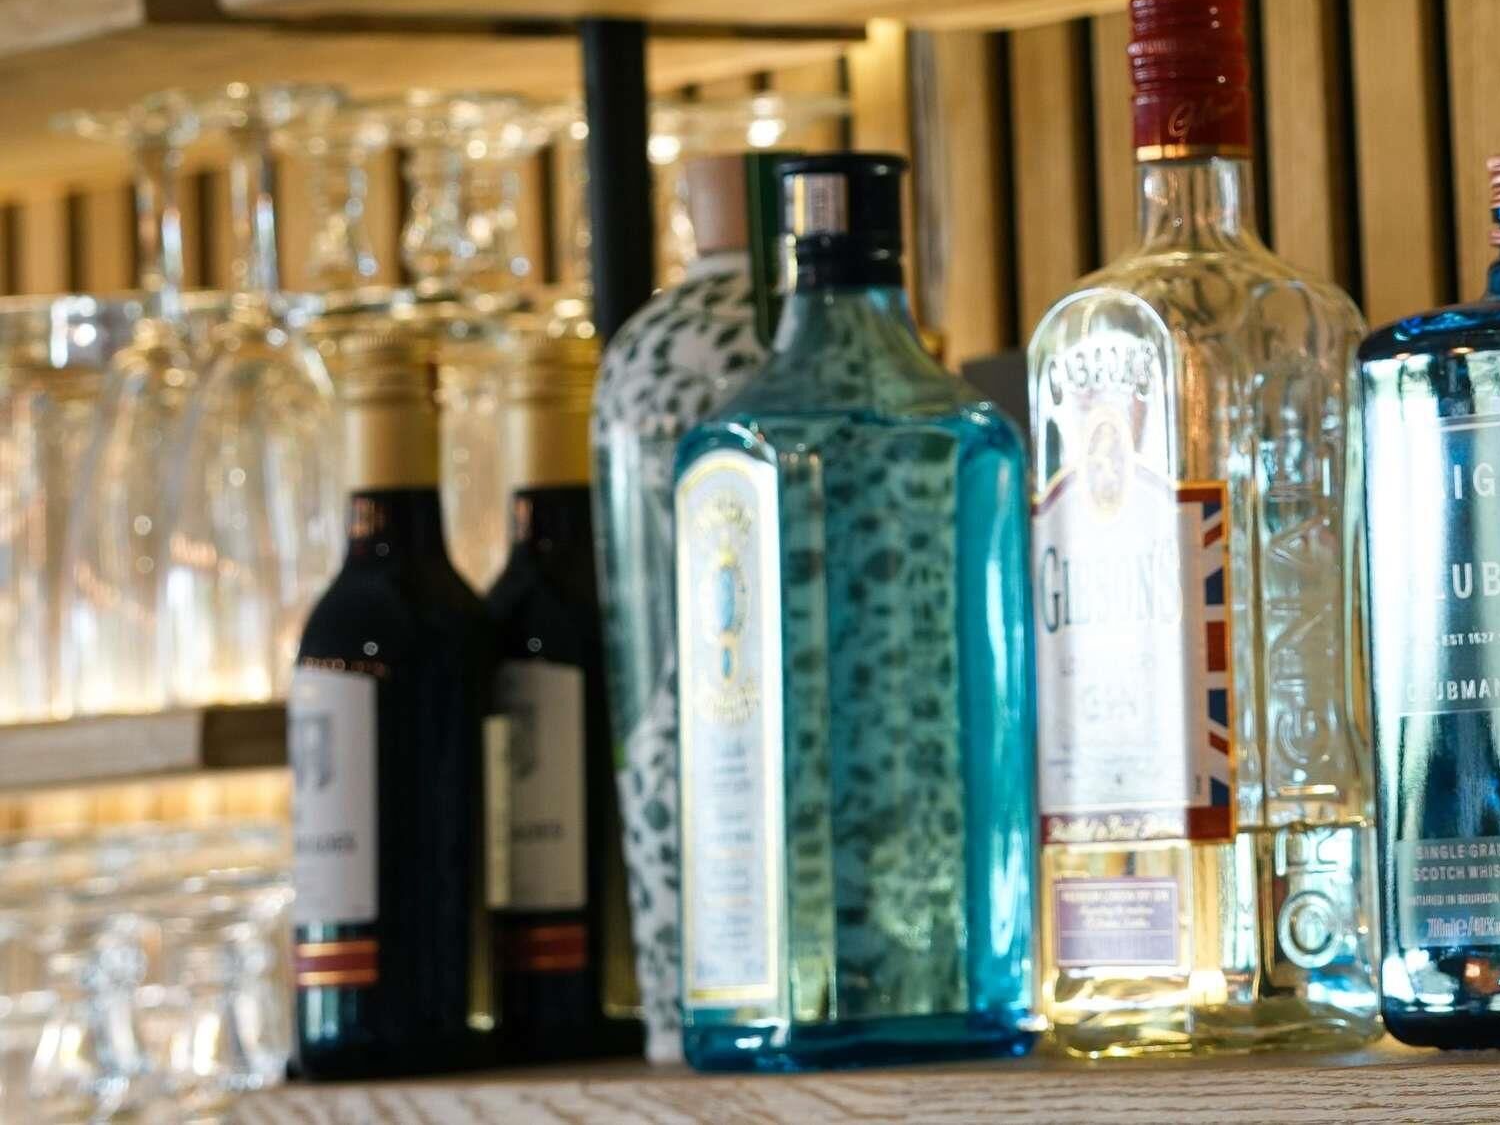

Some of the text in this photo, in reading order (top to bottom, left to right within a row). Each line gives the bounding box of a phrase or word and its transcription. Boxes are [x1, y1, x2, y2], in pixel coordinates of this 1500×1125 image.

[1468, 631, 1495, 645] 1627
[1416, 844, 1466, 861] SINGLE
[1413, 866, 1465, 882] SCOTCH
